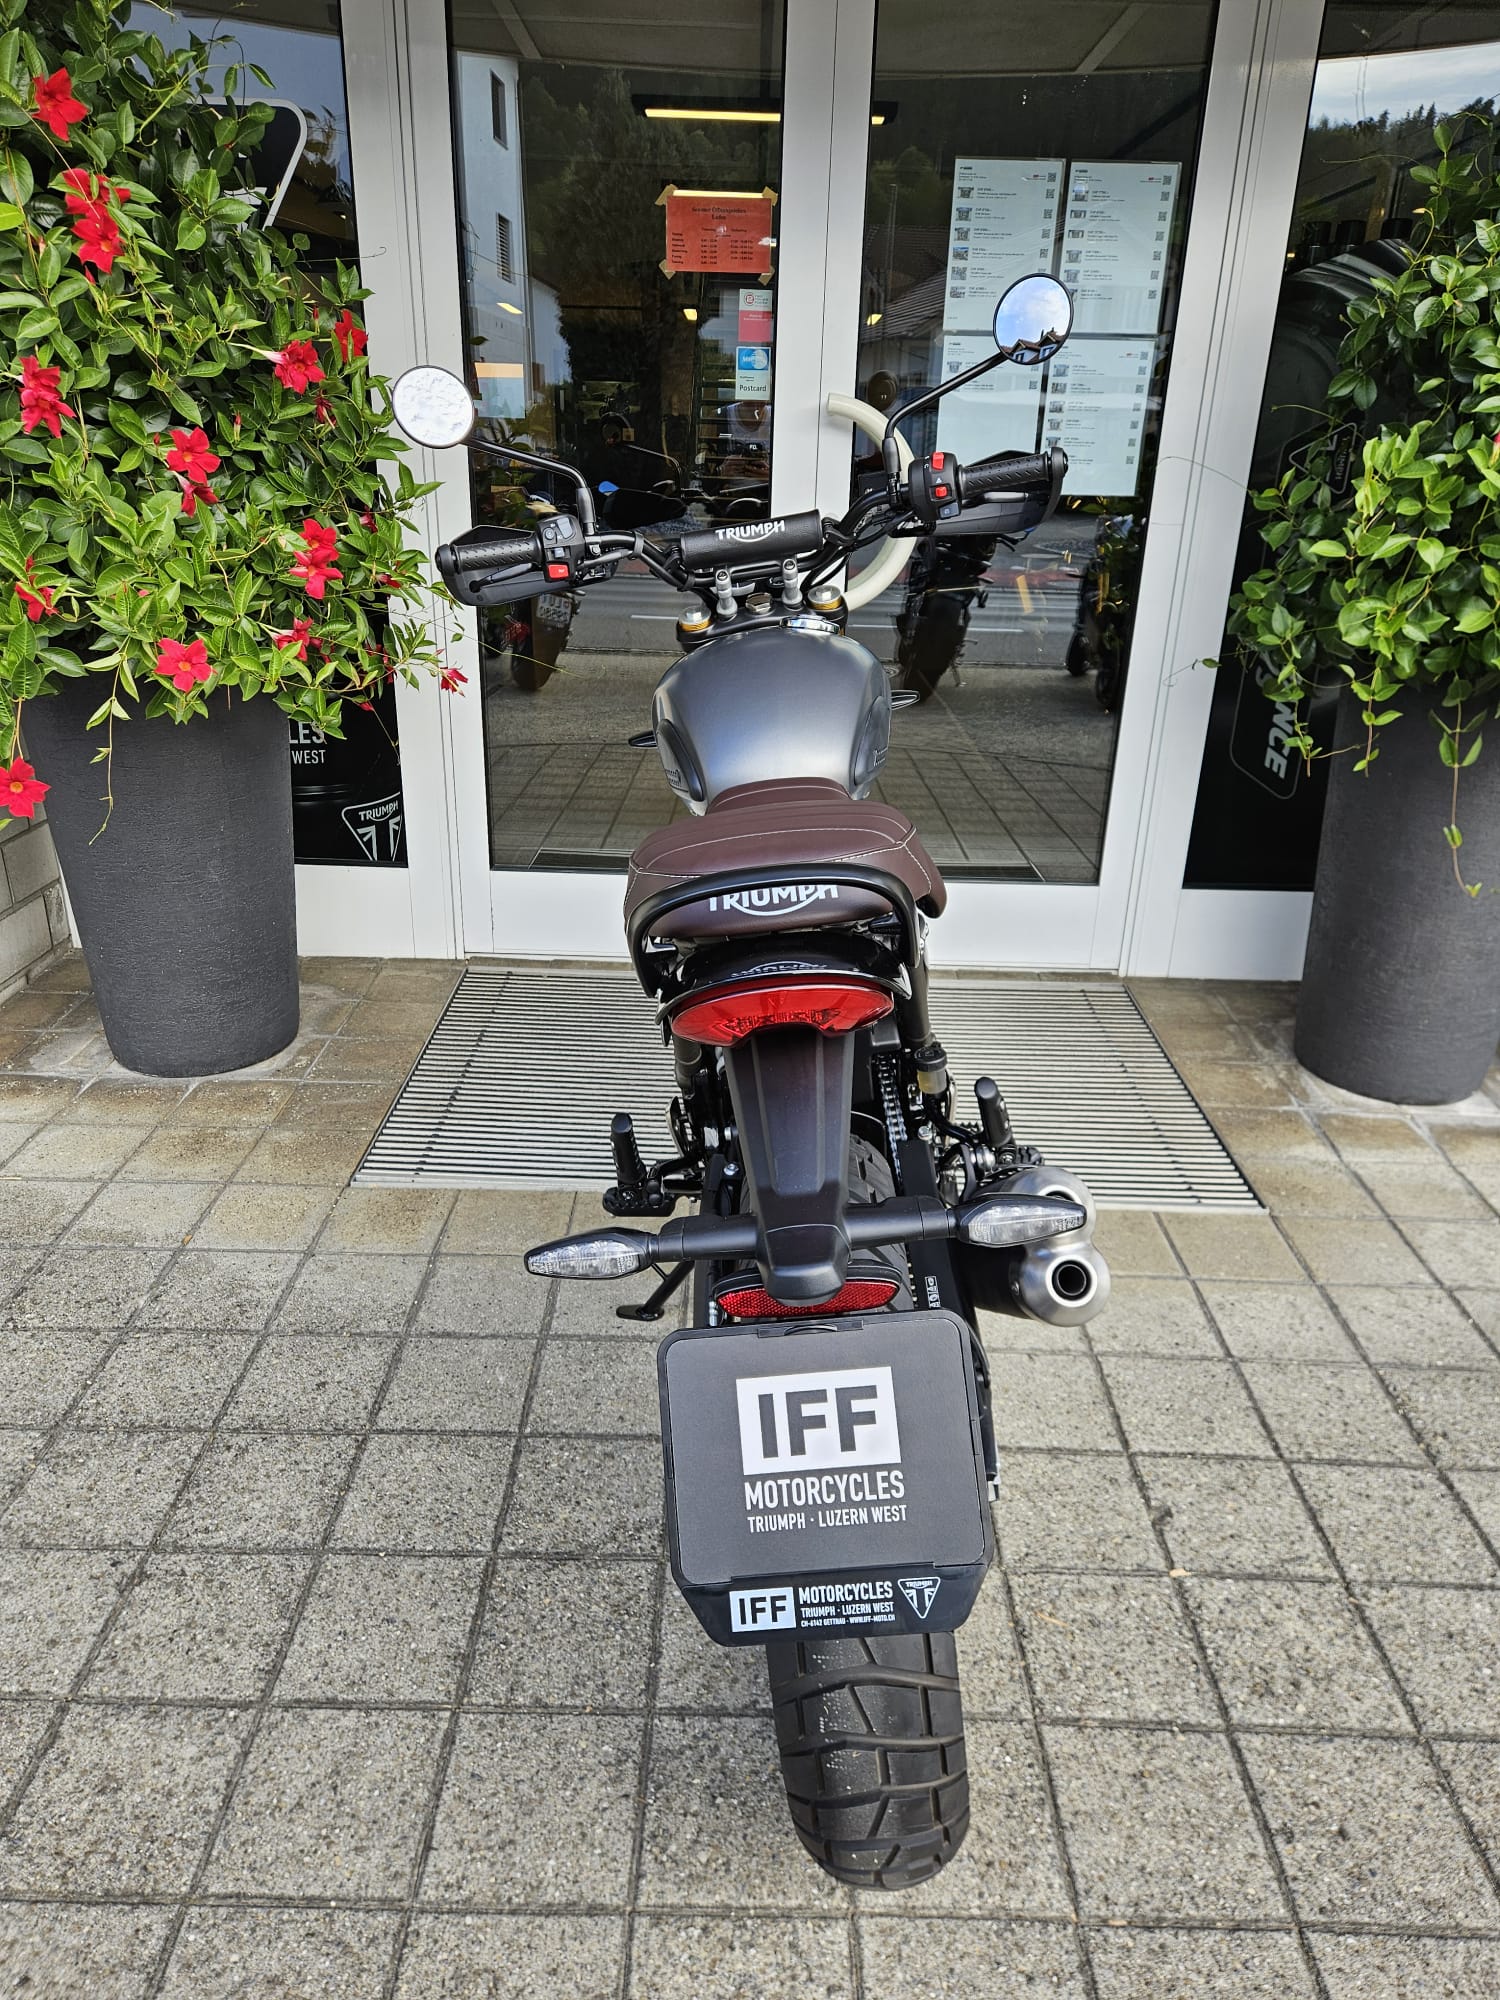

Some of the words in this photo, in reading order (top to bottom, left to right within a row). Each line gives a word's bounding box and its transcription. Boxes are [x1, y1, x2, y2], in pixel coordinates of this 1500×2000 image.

[739, 384, 767, 392] Postcard
[715, 520, 785, 542] TRIUMPH
[291, 750, 326, 765] WEST
[358, 800, 399, 822] TRIUMPH
[758, 1384, 878, 1459] IFF
[744, 1470, 905, 1510] MOTORCYCLES
[747, 1512, 806, 1533] TRIUMPH
[818, 1507, 869, 1528] LUZERN
[872, 1505, 907, 1523] WEST
[798, 1581, 894, 1605] MOTORCYCLES
[905, 1580, 933, 1589] TRIUMPH
[738, 1595, 787, 1626] IFF
[800, 1606, 836, 1618] TRIUMPH
[842, 1603, 871, 1615] LUZERN
[872, 1601, 895, 1613] WEST
